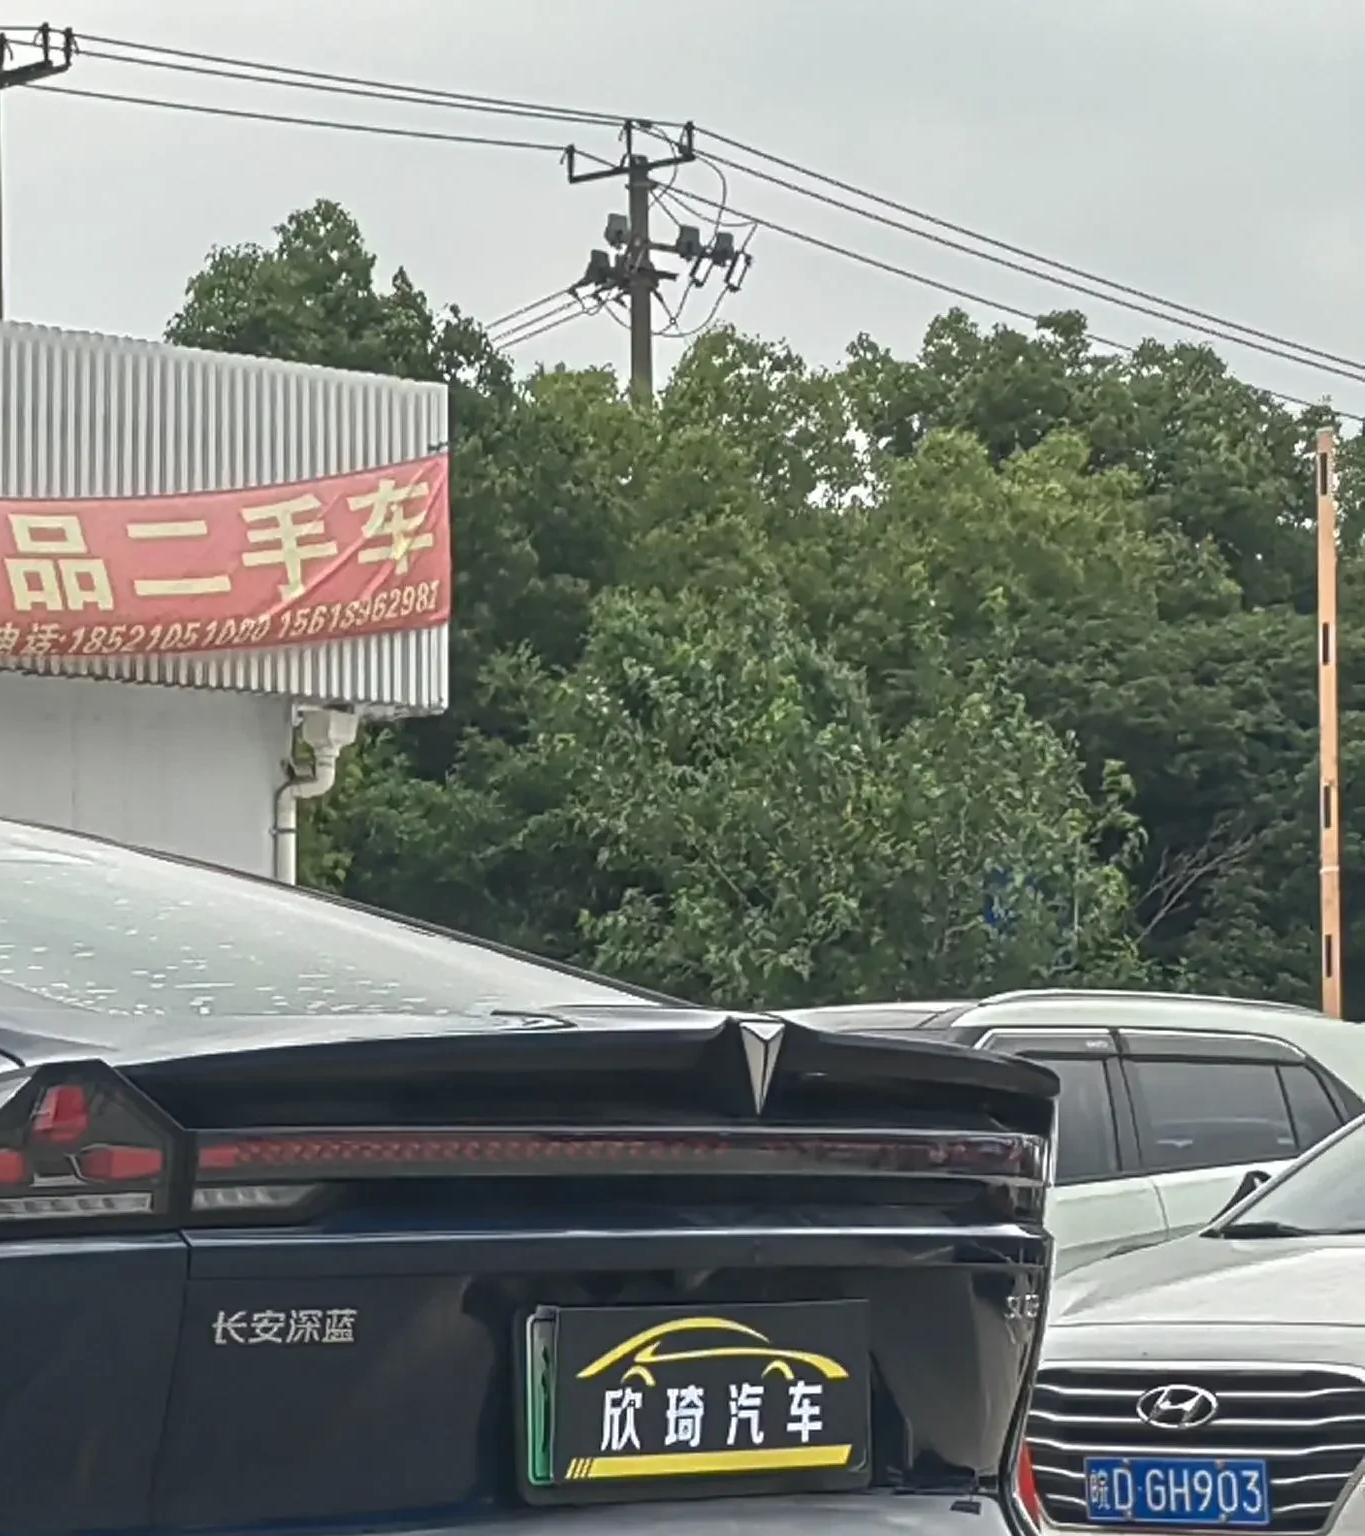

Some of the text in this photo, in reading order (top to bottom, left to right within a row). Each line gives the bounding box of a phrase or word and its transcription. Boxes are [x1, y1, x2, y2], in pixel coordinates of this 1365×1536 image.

[212, 1308, 358, 1345] 长安深蓝
[600, 1380, 824, 1451] 欣琦汽车
